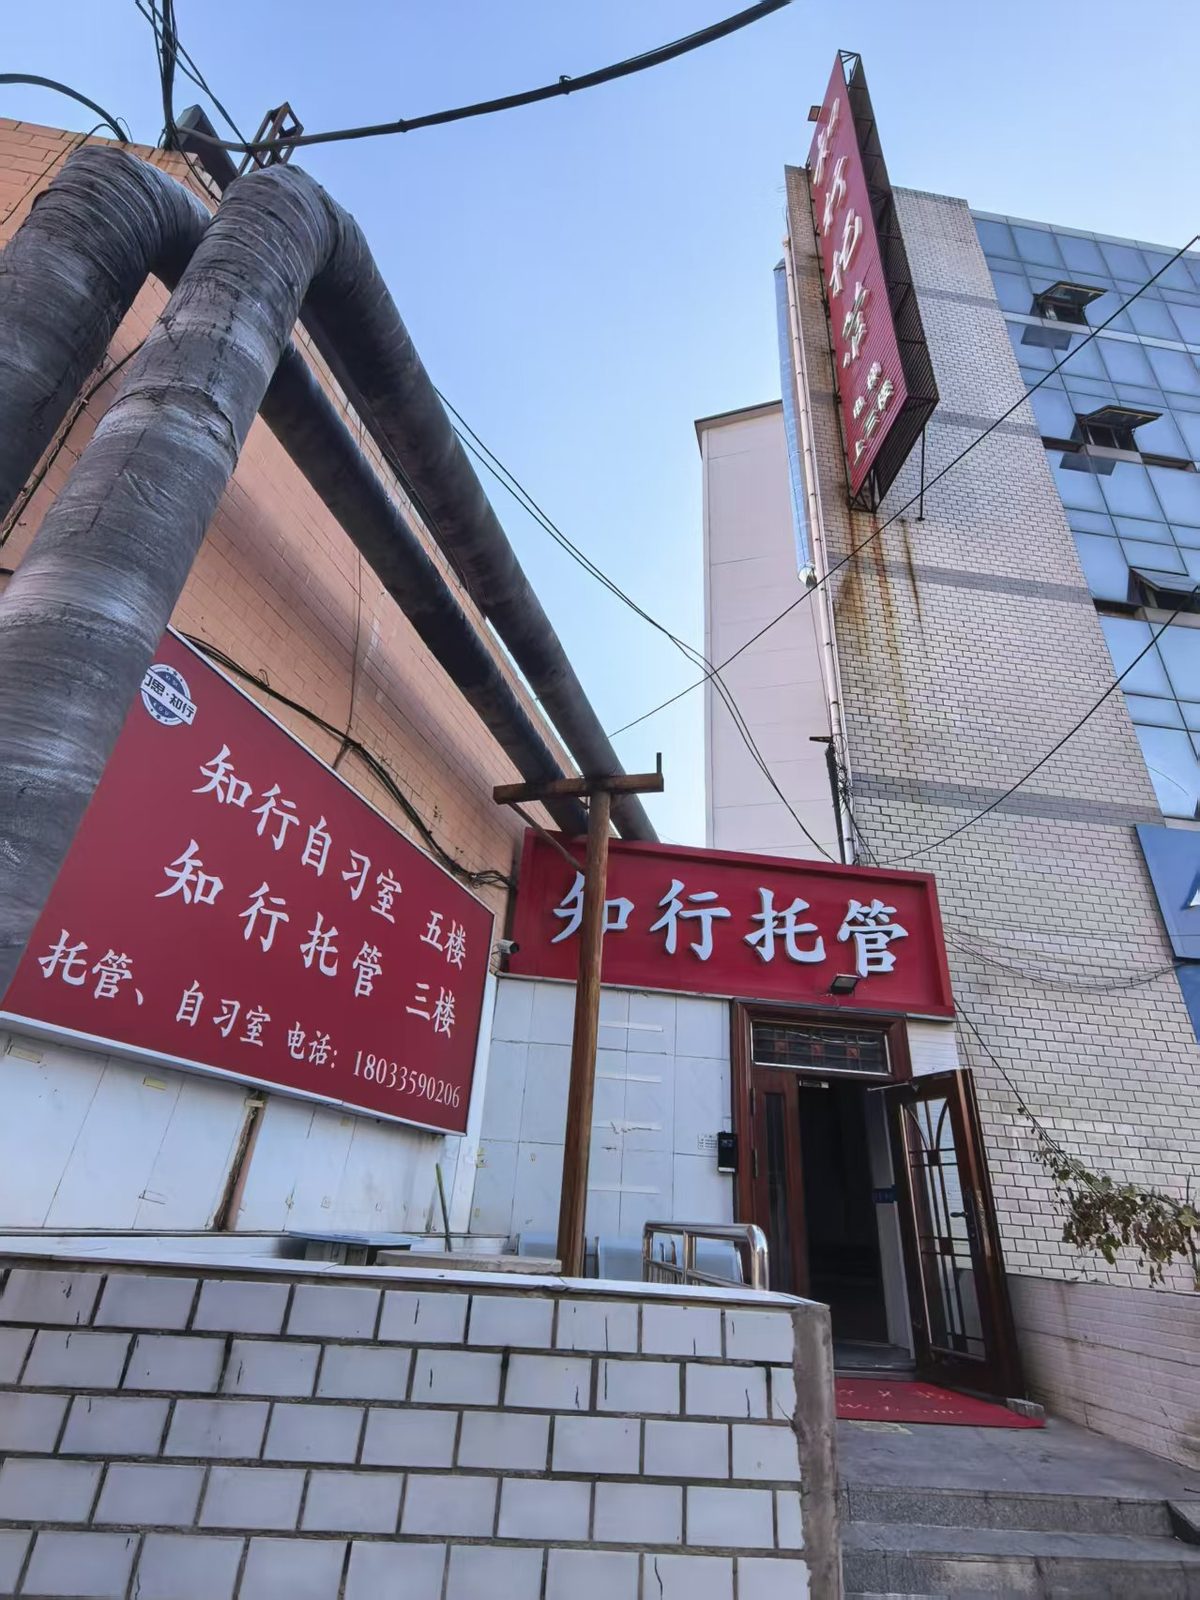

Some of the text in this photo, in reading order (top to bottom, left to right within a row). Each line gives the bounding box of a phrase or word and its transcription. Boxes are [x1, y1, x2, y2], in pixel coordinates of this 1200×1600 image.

[192, 744, 466, 971] 知行自习室 五楼
[551, 870, 908, 978] 知行托管
[155, 839, 455, 1038] 知行托管 三楼
[353, 1050, 461, 1108] 18033590206
